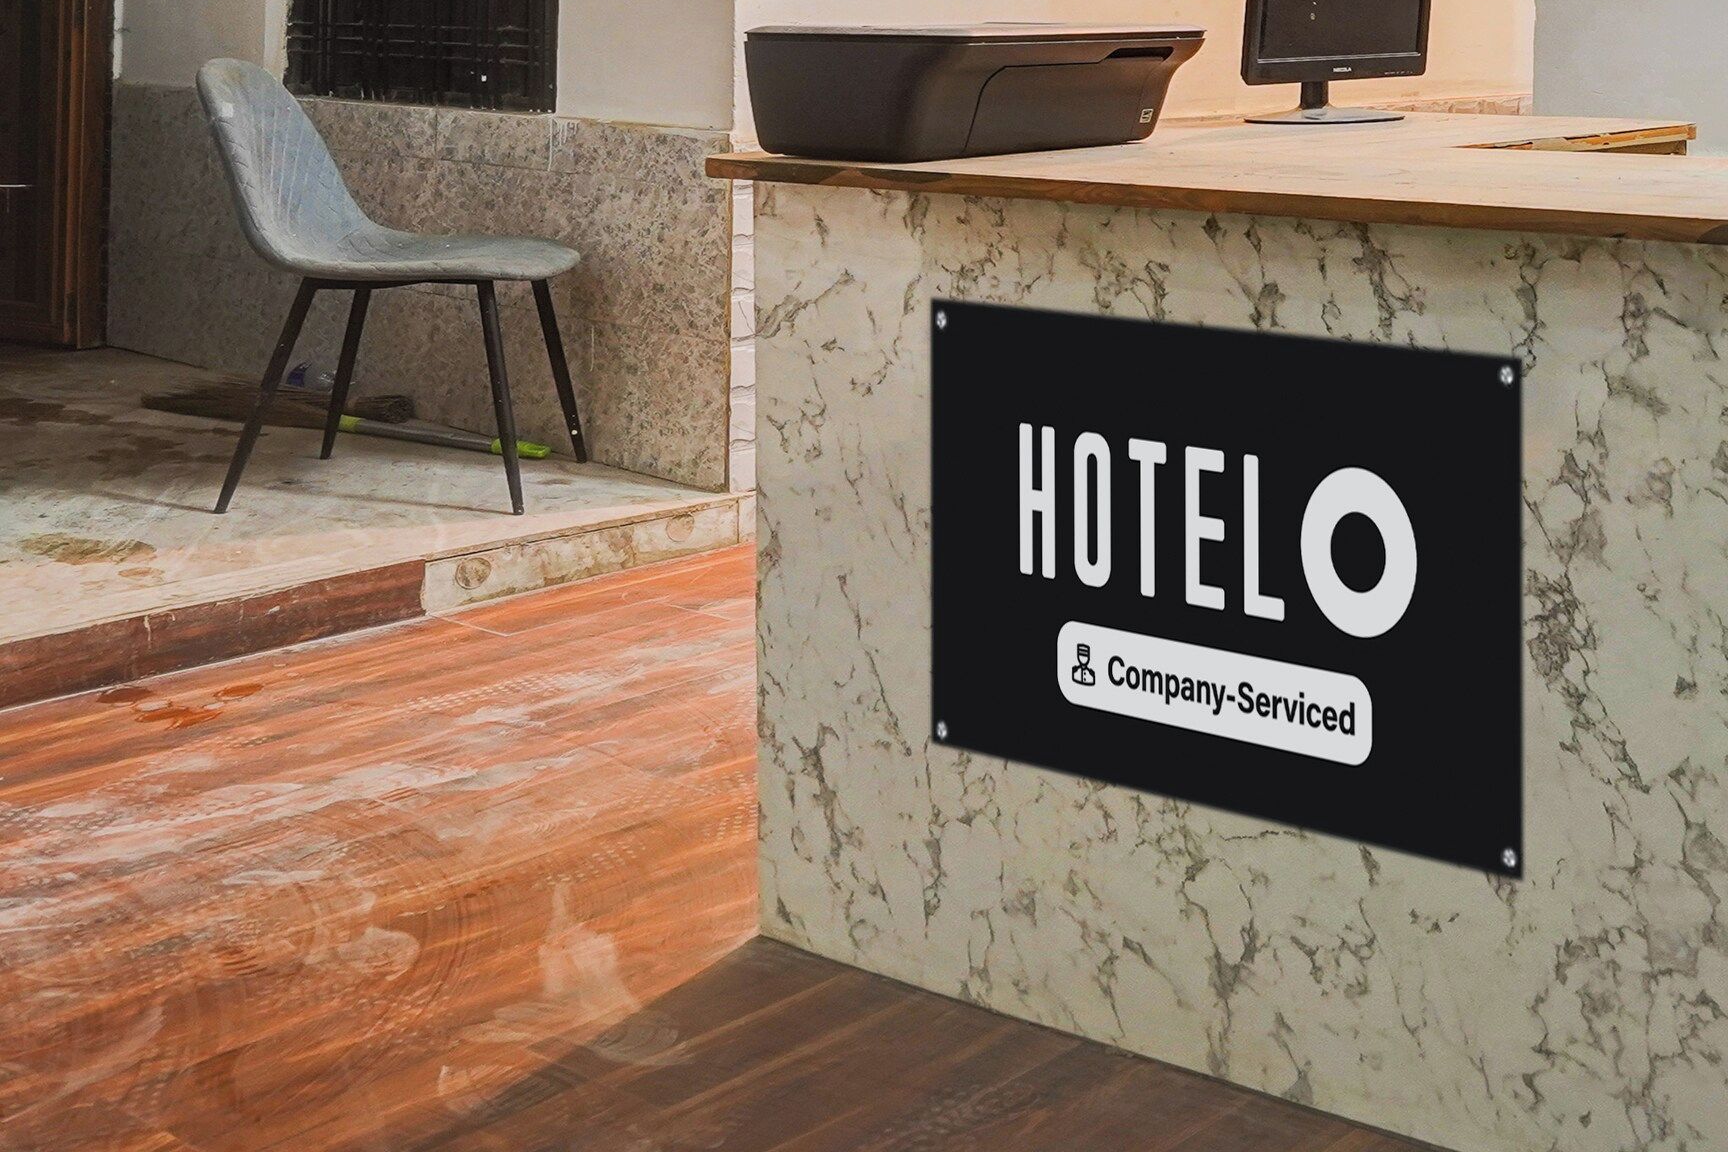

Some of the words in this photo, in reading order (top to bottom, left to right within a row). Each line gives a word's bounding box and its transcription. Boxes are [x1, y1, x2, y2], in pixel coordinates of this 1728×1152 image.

[1018, 421, 1286, 622] HOTEL
[1300, 466, 1418, 639] O
[1107, 655, 1357, 737] Company-Serviced
